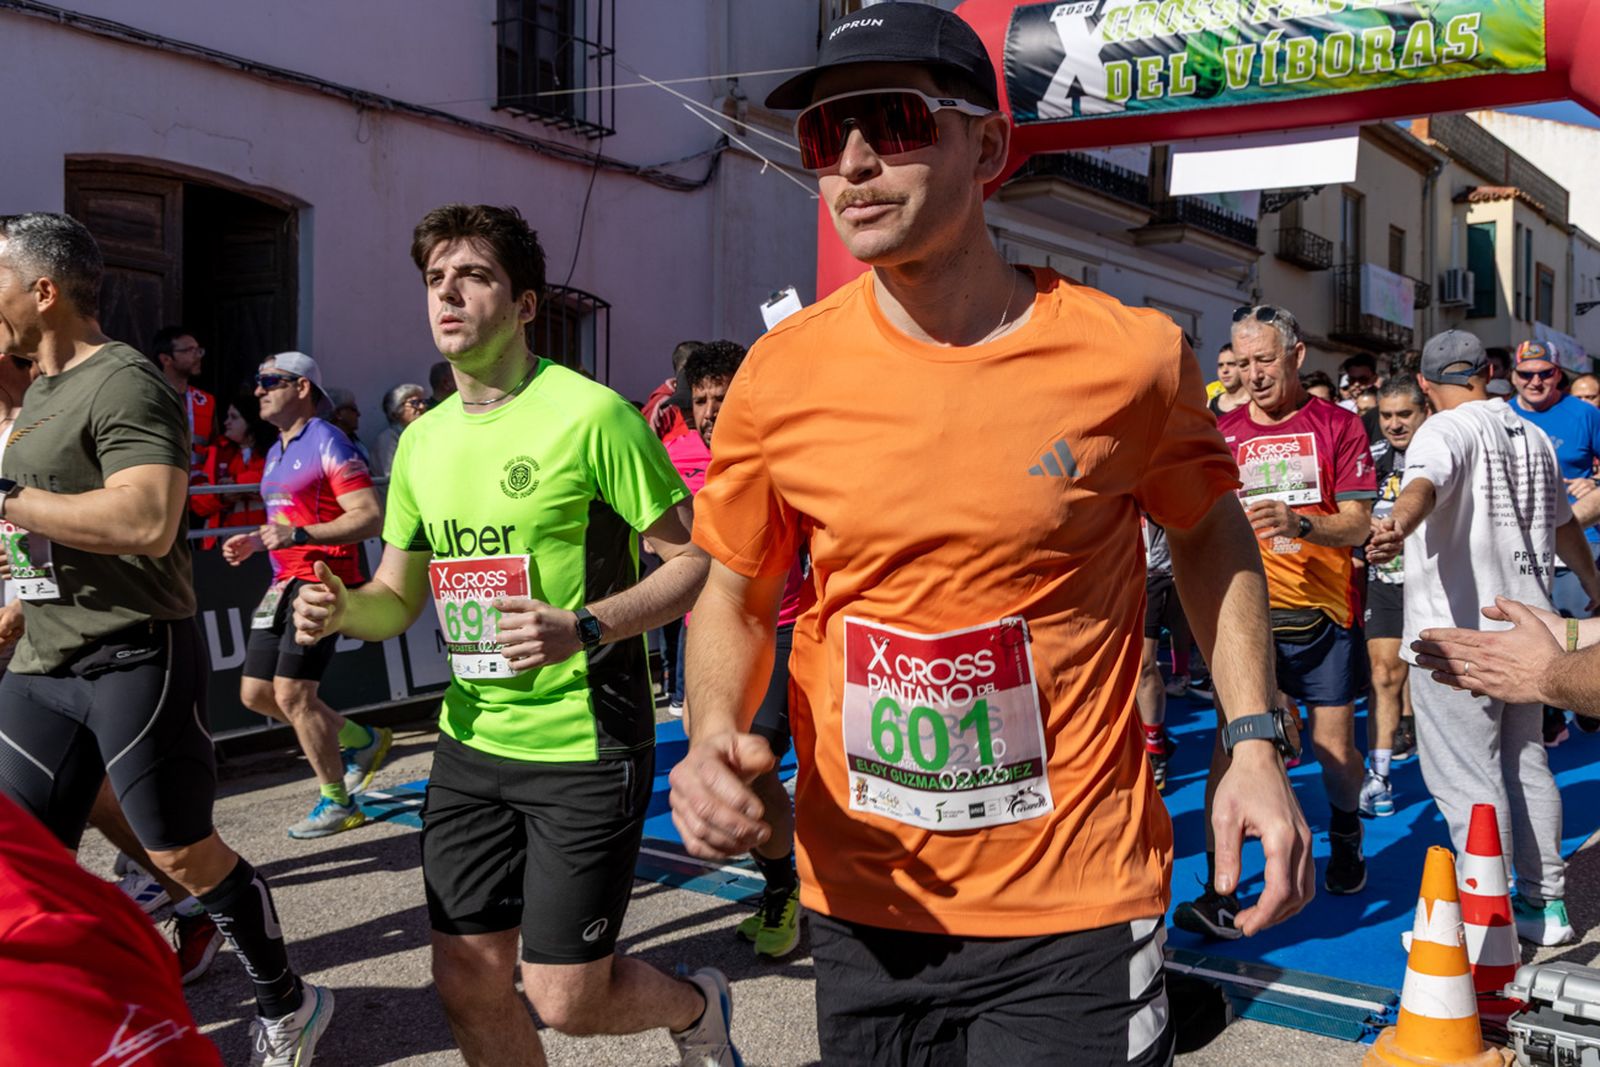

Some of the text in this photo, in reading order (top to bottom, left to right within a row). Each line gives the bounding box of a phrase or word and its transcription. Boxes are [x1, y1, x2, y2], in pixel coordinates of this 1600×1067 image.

[1056, 3, 1095, 17] 2026
[829, 19, 884, 40] KIPRUN
[1104, 12, 1482, 103] DEL VÍBORAS
[1258, 441, 1301, 455] CROSS
[428, 518, 516, 557] Uber
[437, 567, 508, 589] X CROSS
[439, 587, 495, 601] PANTANO
[444, 600, 502, 642] 691
[867, 634, 892, 674] X
[895, 649, 996, 686] CROSS
[867, 672, 999, 709] PANTANO DEL
[870, 696, 995, 772] 601
[855, 759, 887, 778] ELOY
[890, 768, 949, 790] GUZMAN
